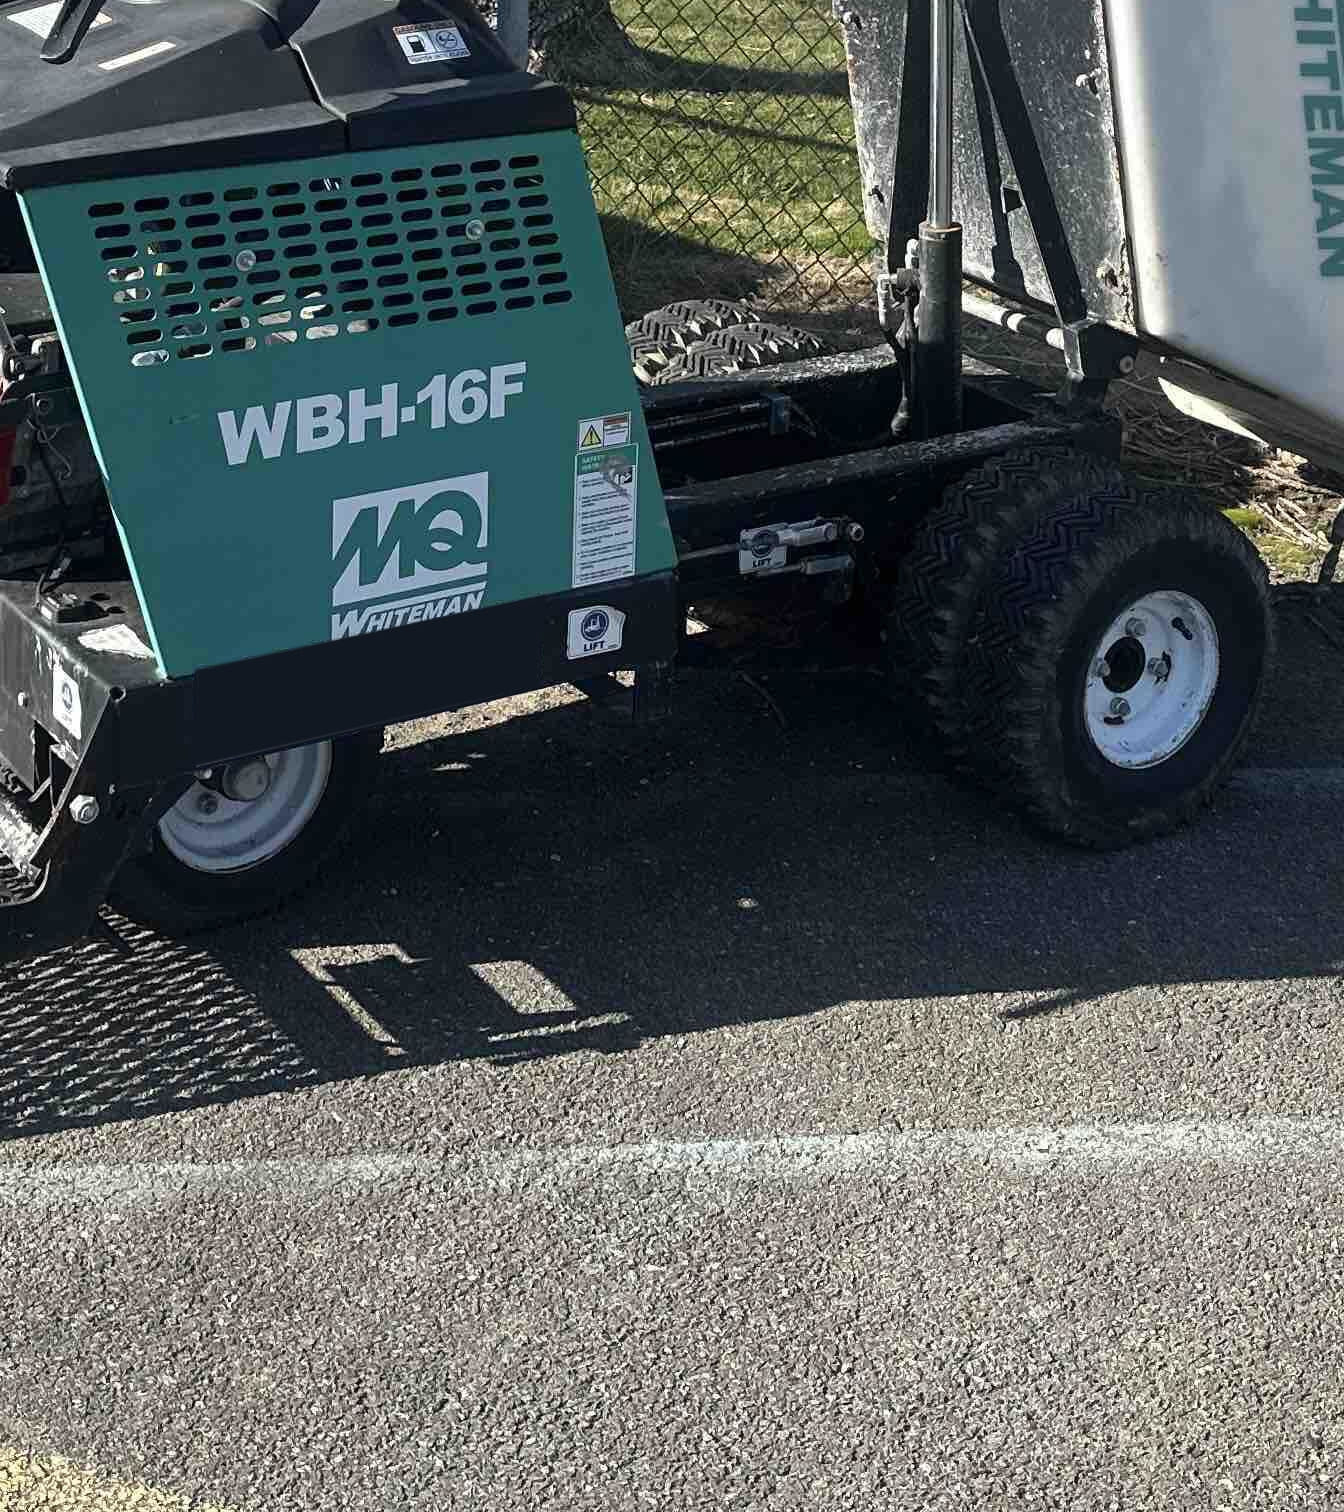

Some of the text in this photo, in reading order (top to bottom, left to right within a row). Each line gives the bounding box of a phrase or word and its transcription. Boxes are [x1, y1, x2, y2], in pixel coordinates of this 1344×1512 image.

[217, 361, 527, 466] WBH-16F
[332, 490, 489, 586] MQ
[331, 581, 488, 641] WHITEMAN
[583, 641, 605, 652] LIFT
